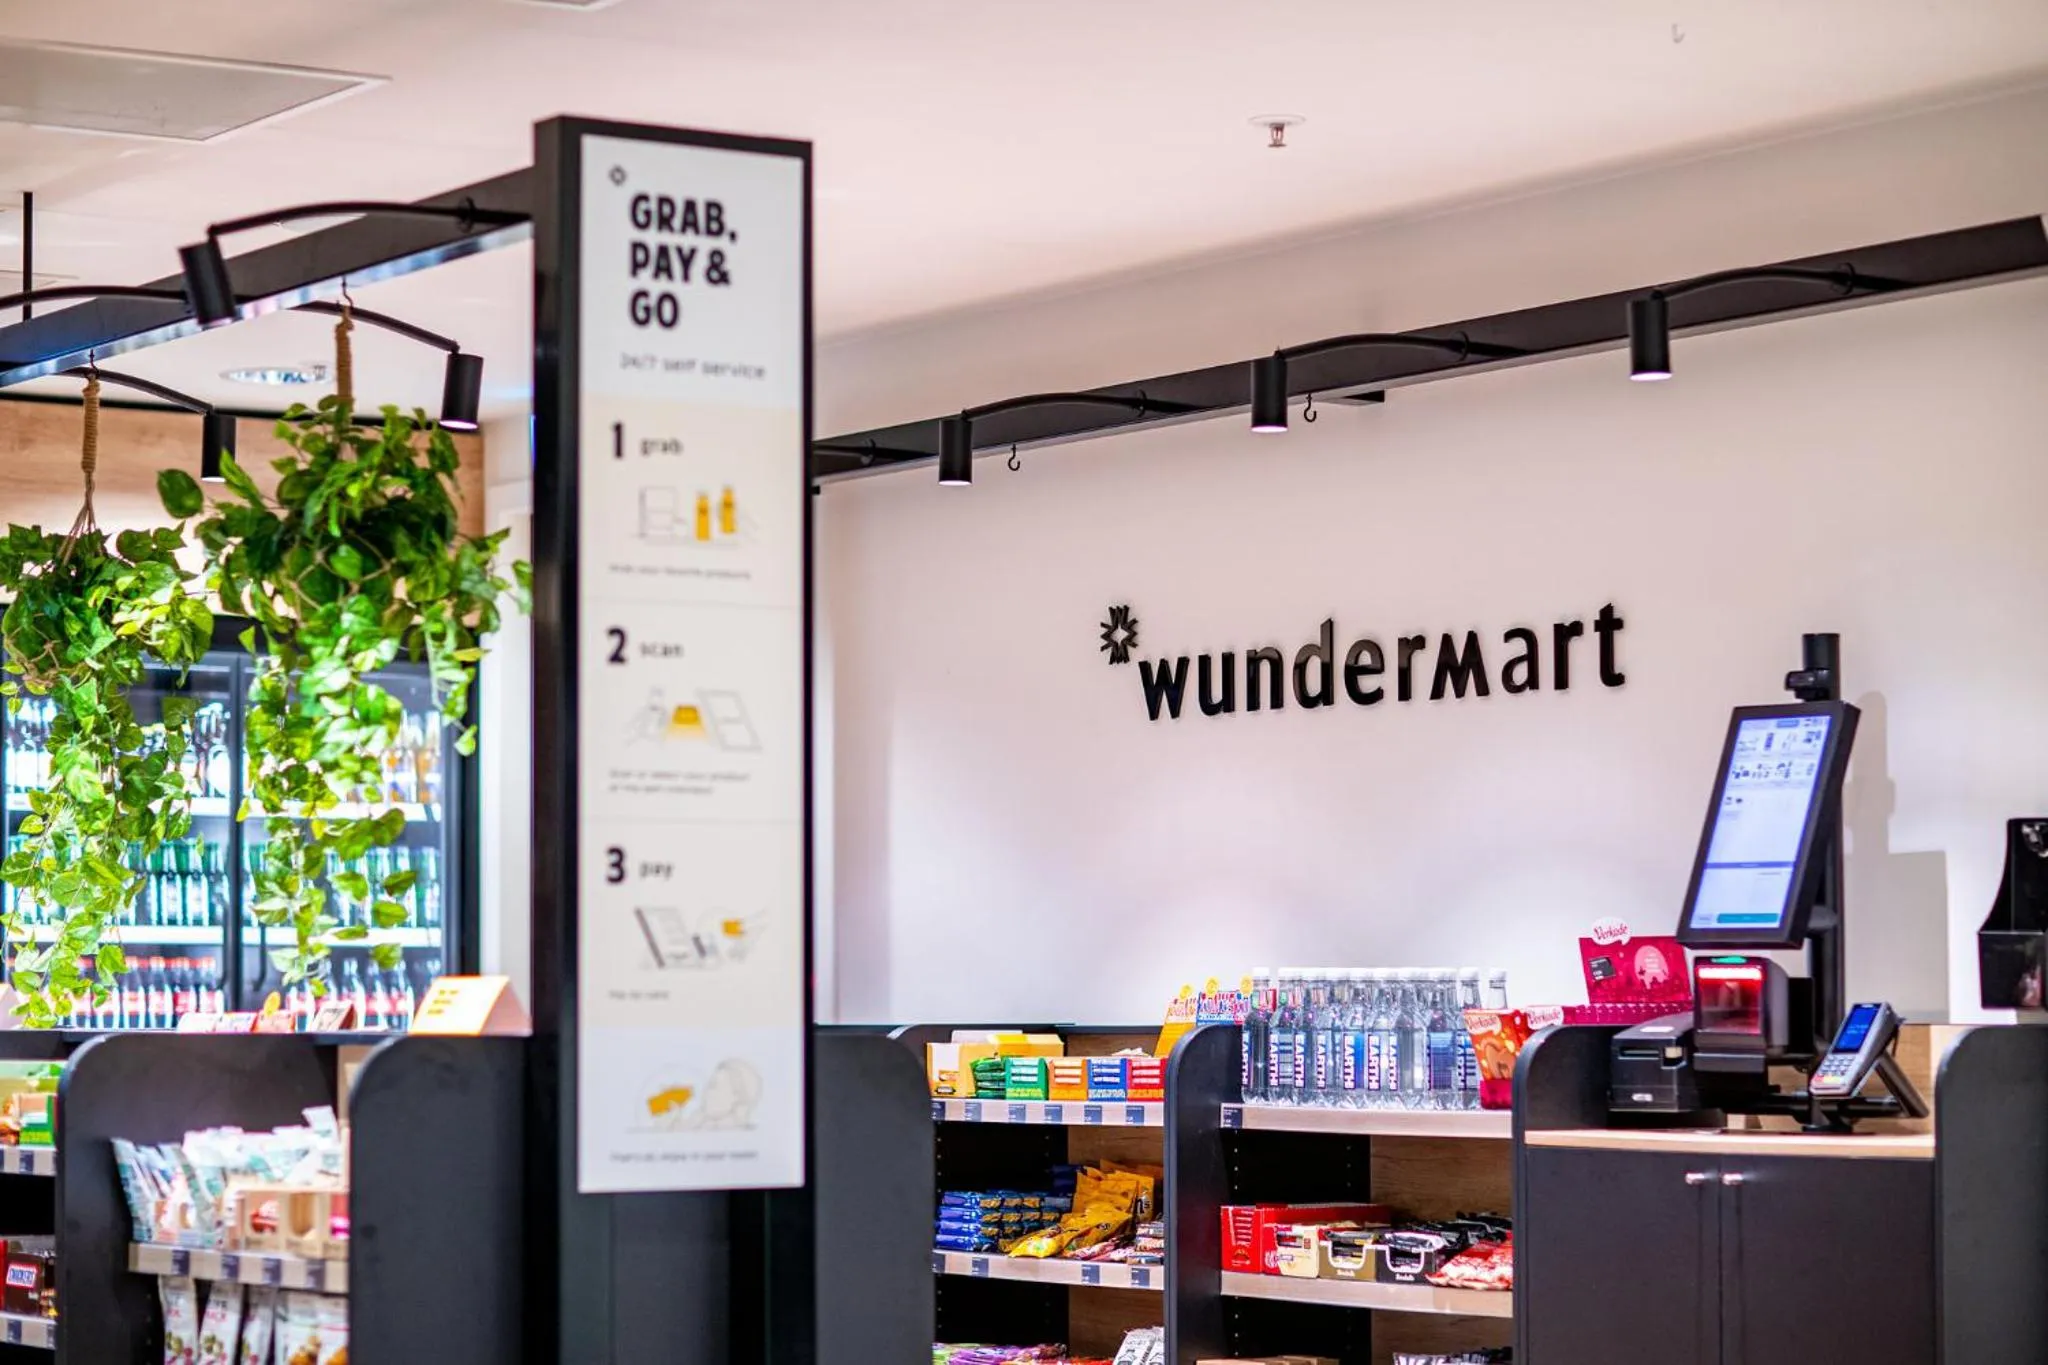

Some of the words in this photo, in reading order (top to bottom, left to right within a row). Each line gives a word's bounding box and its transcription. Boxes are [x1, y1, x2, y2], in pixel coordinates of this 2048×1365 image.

[630, 241, 697, 284] PAY
[705, 249, 731, 286] &
[630, 289, 680, 330] GO
[612, 421, 624, 460] 1
[606, 625, 627, 666] 2
[605, 845, 627, 885] 3
[1343, 1034, 1355, 1089] EARTH
[1367, 1034, 1380, 1090] EARTH
